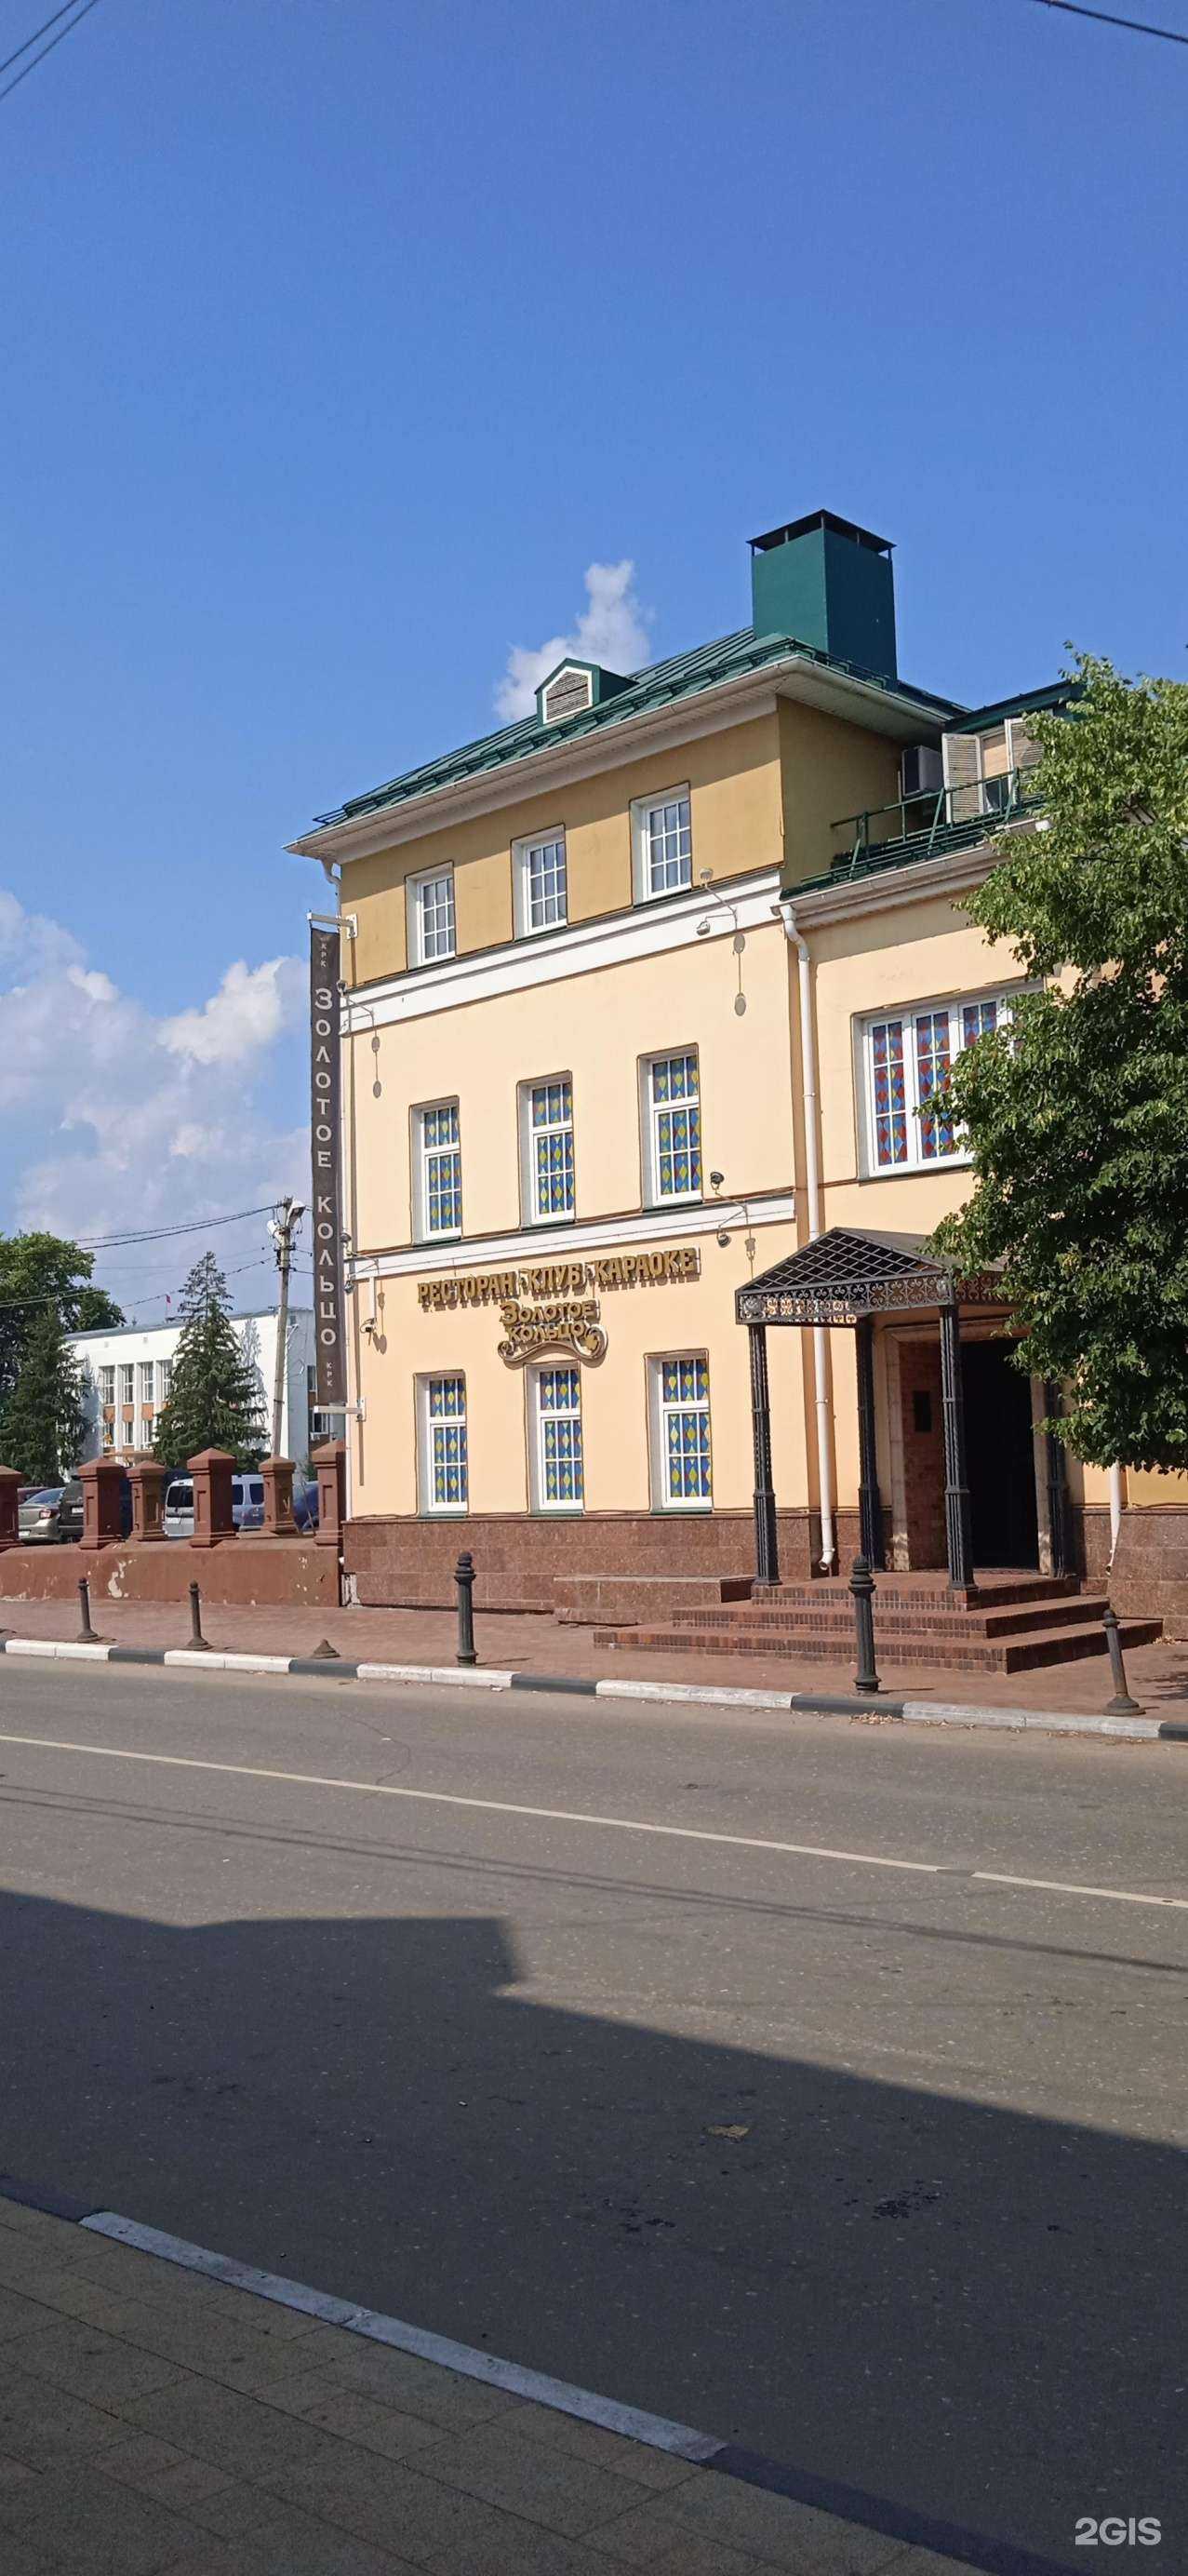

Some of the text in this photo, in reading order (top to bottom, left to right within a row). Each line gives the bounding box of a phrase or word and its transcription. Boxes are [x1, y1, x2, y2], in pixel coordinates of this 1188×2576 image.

[314, 987, 337, 1346] ЗОЛОТОЕ КОЛЬЦО
[417, 1247, 698, 1303] РЕСТОРАН КЛУБ КАРАОКЕ
[508, 1322, 586, 1342] КОЛЬЦО
